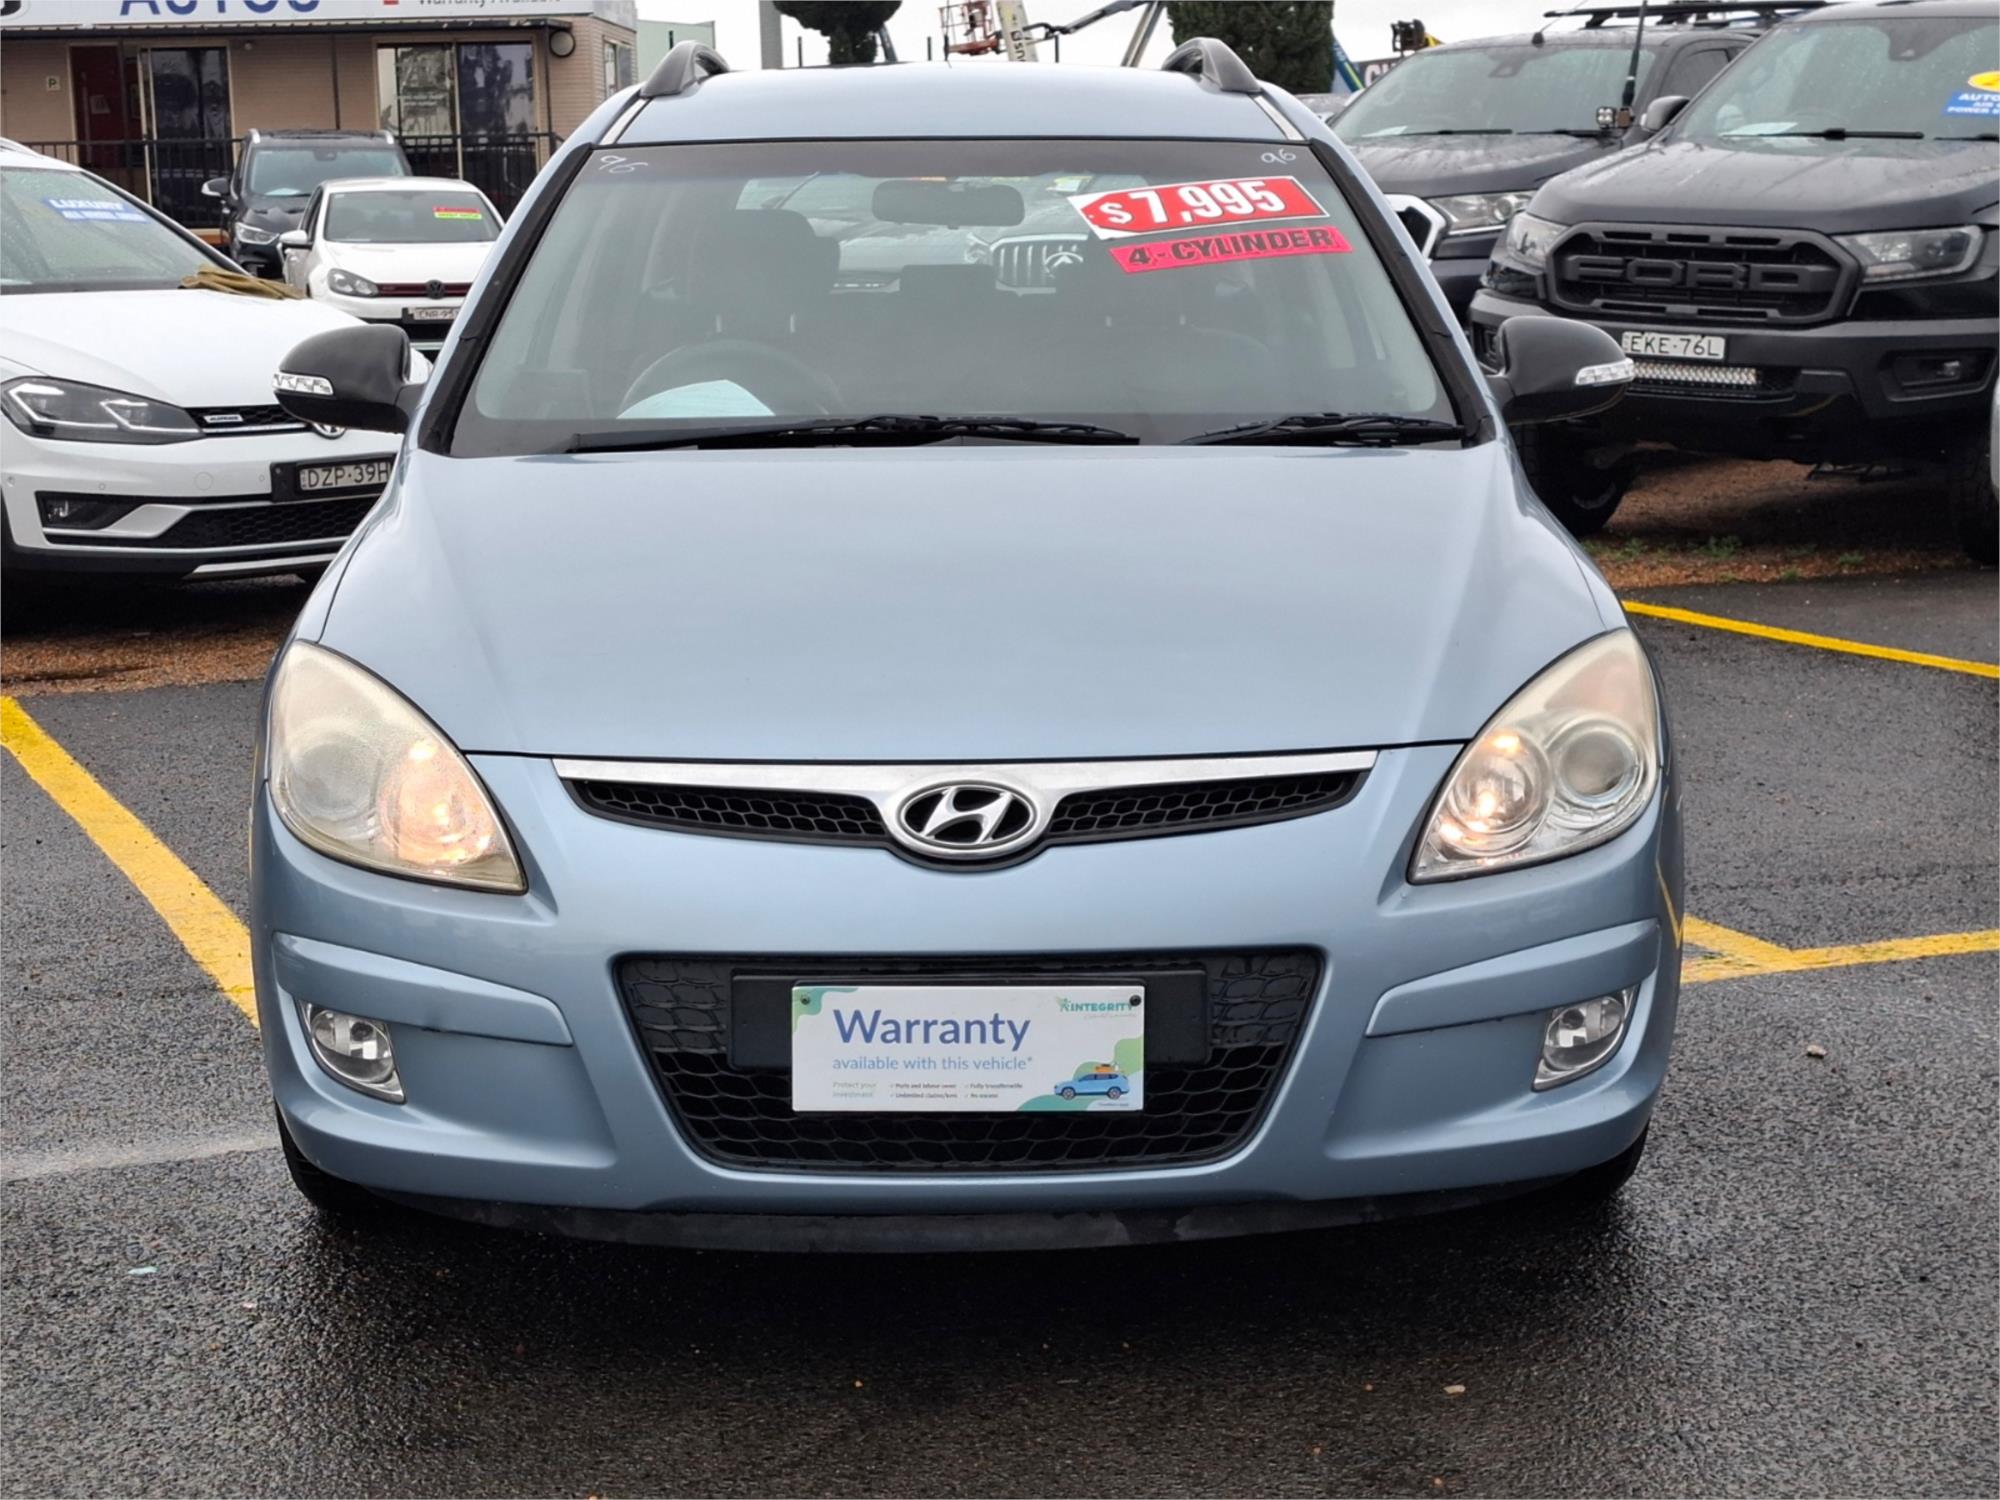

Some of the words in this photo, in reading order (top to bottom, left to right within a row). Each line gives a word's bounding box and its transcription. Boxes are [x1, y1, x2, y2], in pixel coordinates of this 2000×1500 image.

[1261, 148, 1297, 165] 96
[1099, 180, 1286, 224] $7,995
[1565, 254, 1838, 293] FORD
[833, 1009, 1031, 1051] Warranty
[832, 1055, 899, 1071] available
[903, 1056, 938, 1071] with
[942, 1056, 969, 1071] this
